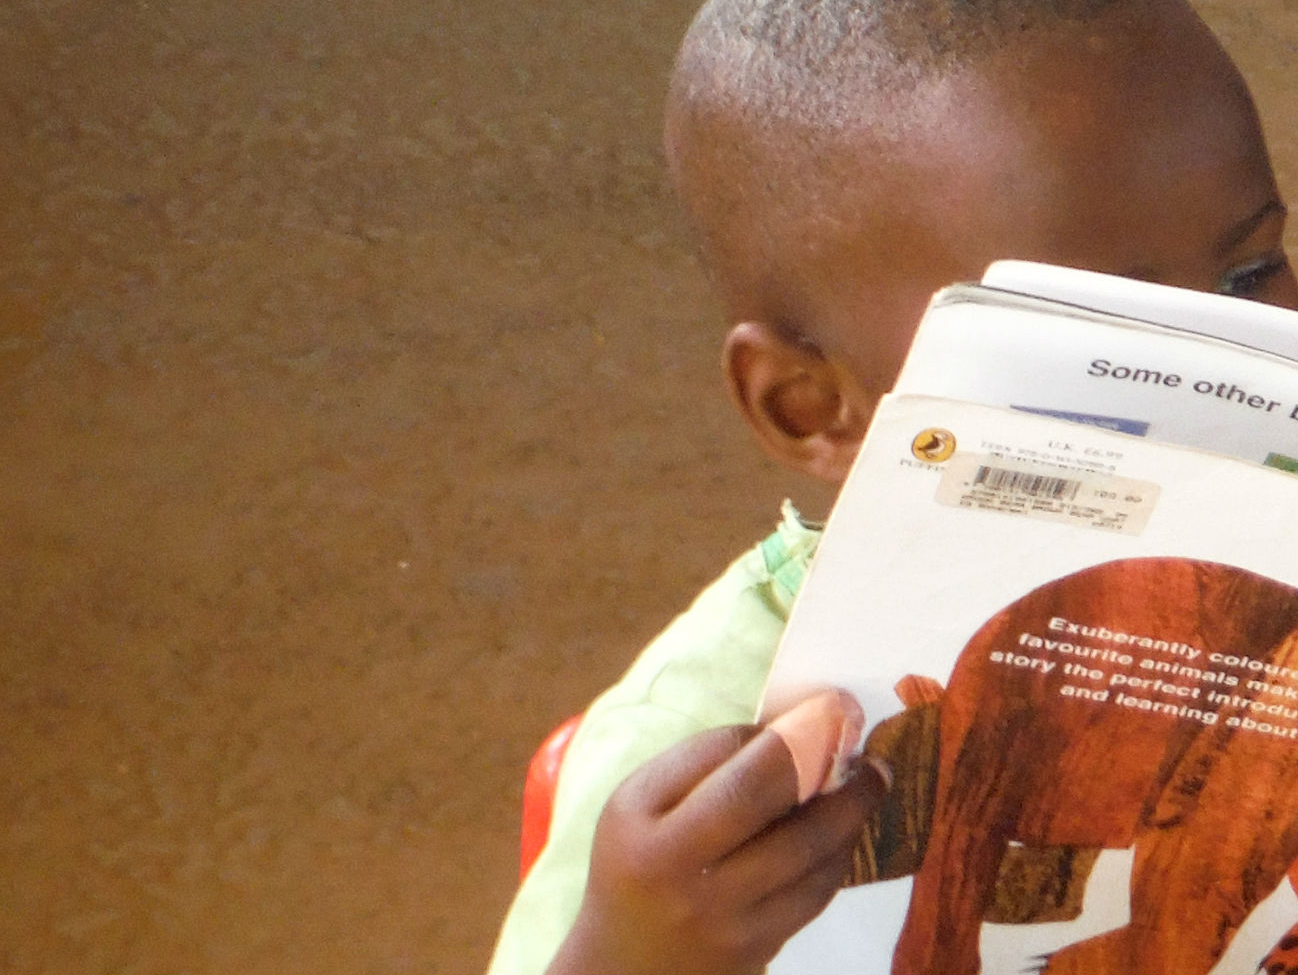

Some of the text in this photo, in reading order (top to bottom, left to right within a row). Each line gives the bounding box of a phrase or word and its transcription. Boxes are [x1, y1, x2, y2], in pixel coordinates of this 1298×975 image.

[1087, 359, 1182, 388] Some
[1193, 380, 1282, 413] other
[1018, 632, 1134, 666] favourite
[1139, 658, 1239, 687] animals
[1048, 616, 1202, 659] Exuberantly
[989, 649, 1056, 674] story
[1063, 662, 1104, 680] the
[1109, 672, 1201, 700] perfect
[1059, 684, 1110, 702] and
[1115, 692, 1220, 725] learning
[1225, 716, 1298, 739] about
